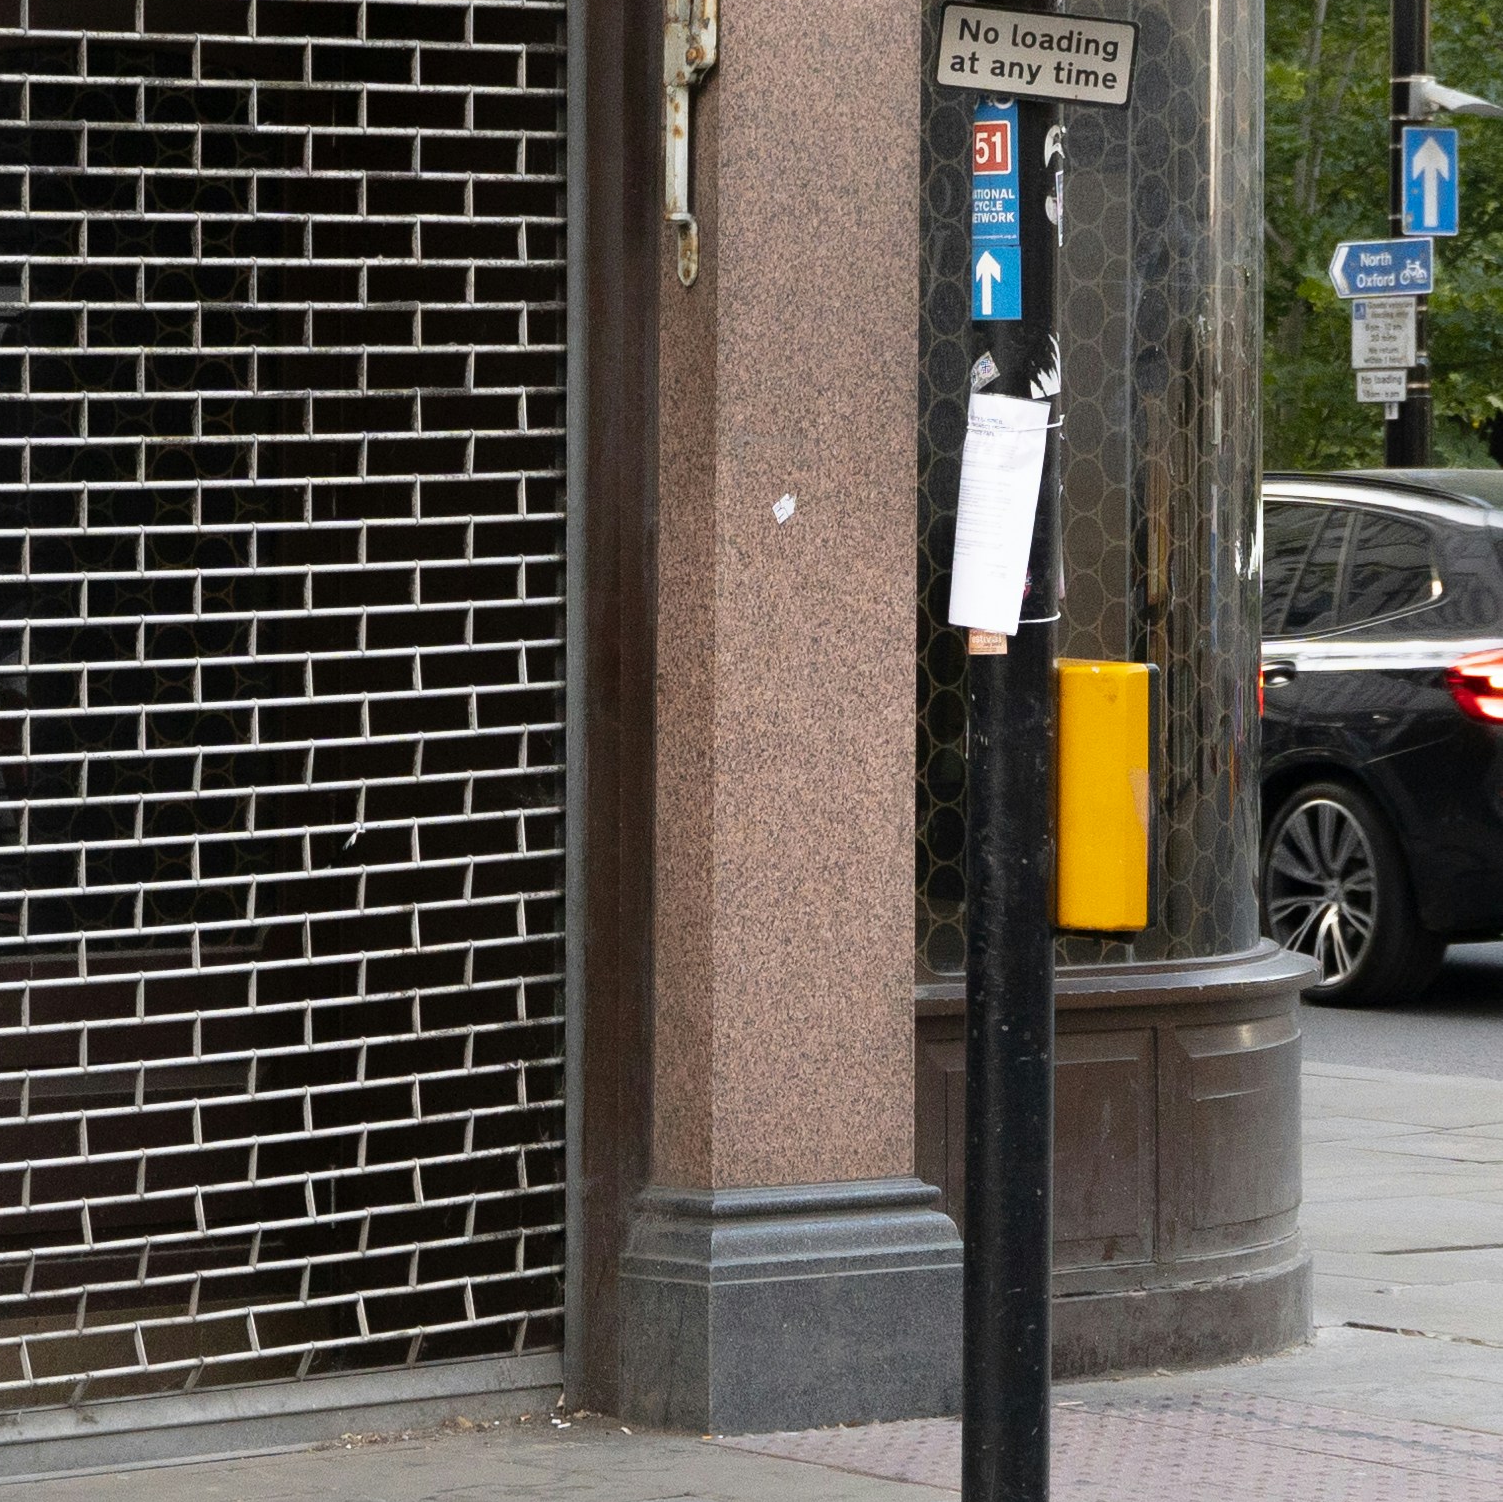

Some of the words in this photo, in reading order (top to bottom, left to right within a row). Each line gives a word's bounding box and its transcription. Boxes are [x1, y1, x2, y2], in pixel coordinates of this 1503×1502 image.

[959, 18, 999, 44] No
[1011, 24, 1118, 62] loading
[950, 51, 979, 74] at
[990, 59, 1042, 85] any
[1054, 61, 1117, 89] time
[976, 131, 1002, 164] 51
[975, 200, 1002, 211] CYCLE
[973, 211, 1014, 223] ETWORK
[1360, 252, 1392, 267] North
[1356, 273, 1395, 288] Oxford
[1361, 376, 1373, 385] No
[1374, 374, 1402, 386] loading
